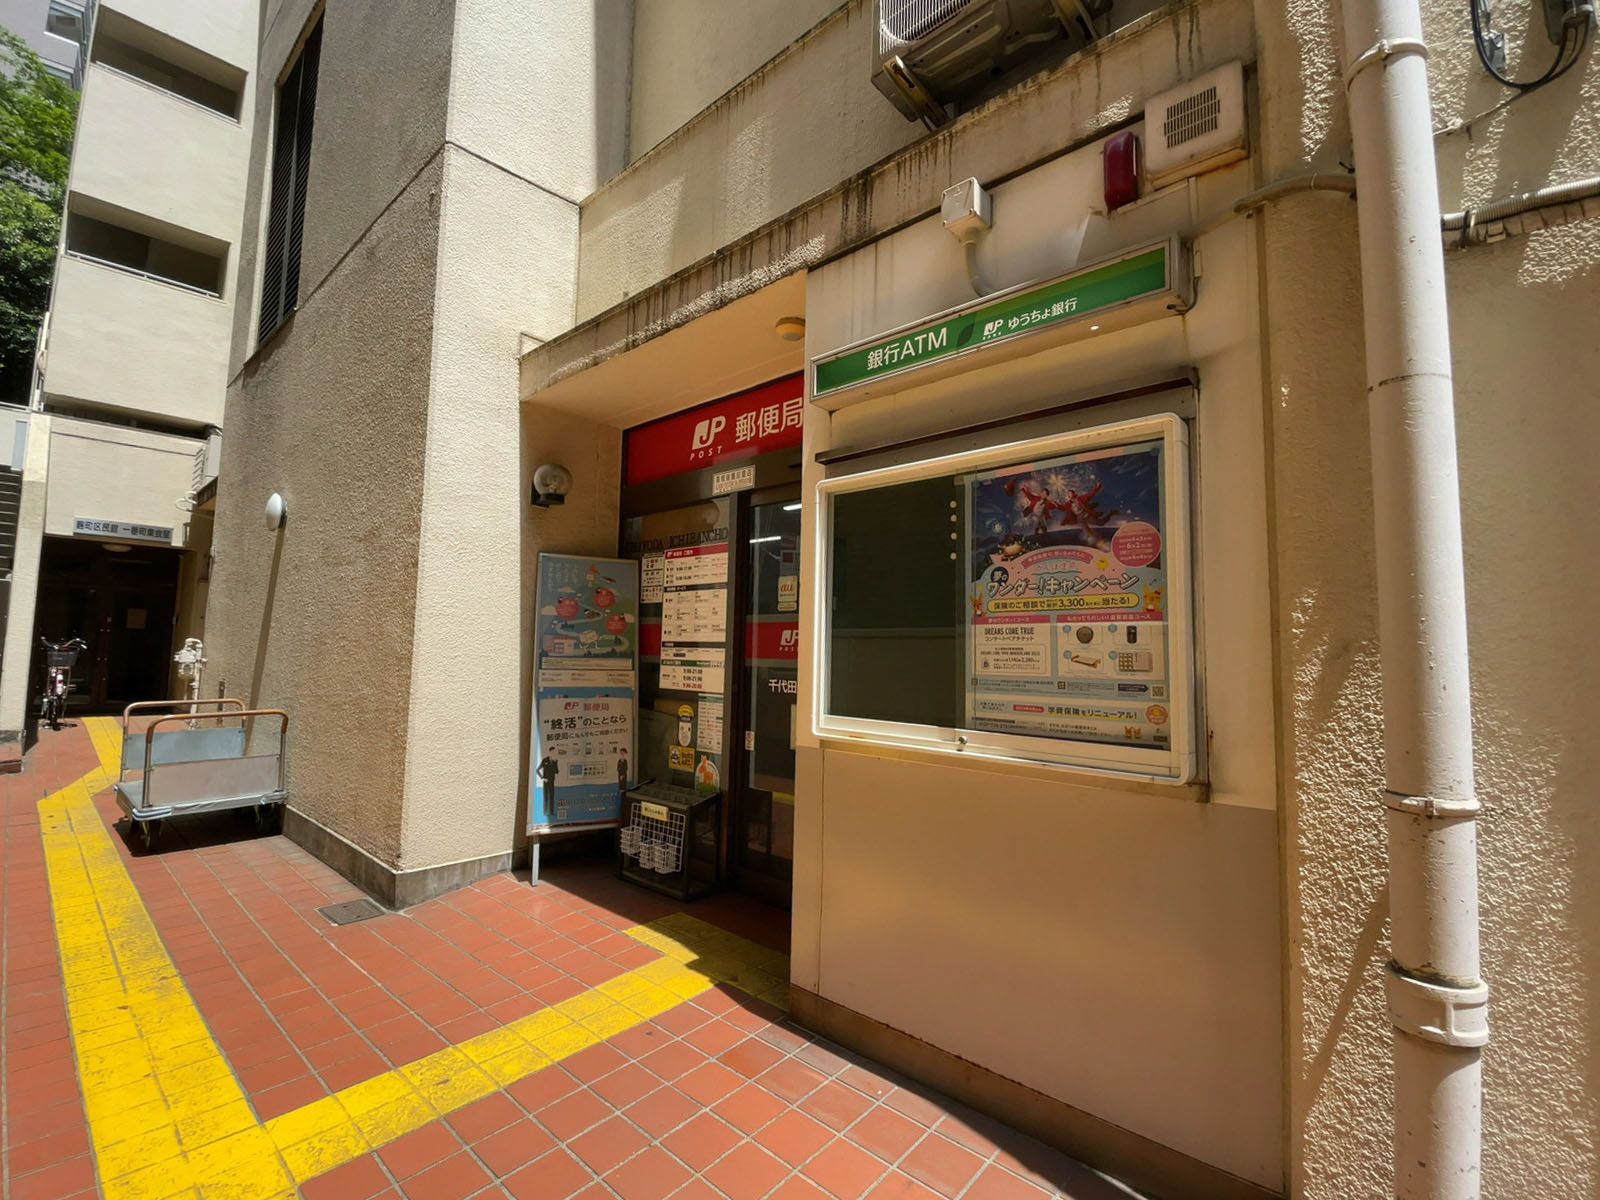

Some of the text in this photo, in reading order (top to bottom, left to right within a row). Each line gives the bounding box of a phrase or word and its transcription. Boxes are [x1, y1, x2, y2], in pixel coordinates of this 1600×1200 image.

[1007, 297, 1079, 330] ゆうちょ銀行
[866, 327, 948, 372] 銀行ATM
[735, 397, 803, 444] 郵便局
[689, 445, 723, 461] POST
[1020, 626, 1035, 635] TRUE
[768, 679, 797, 694] 千代田
